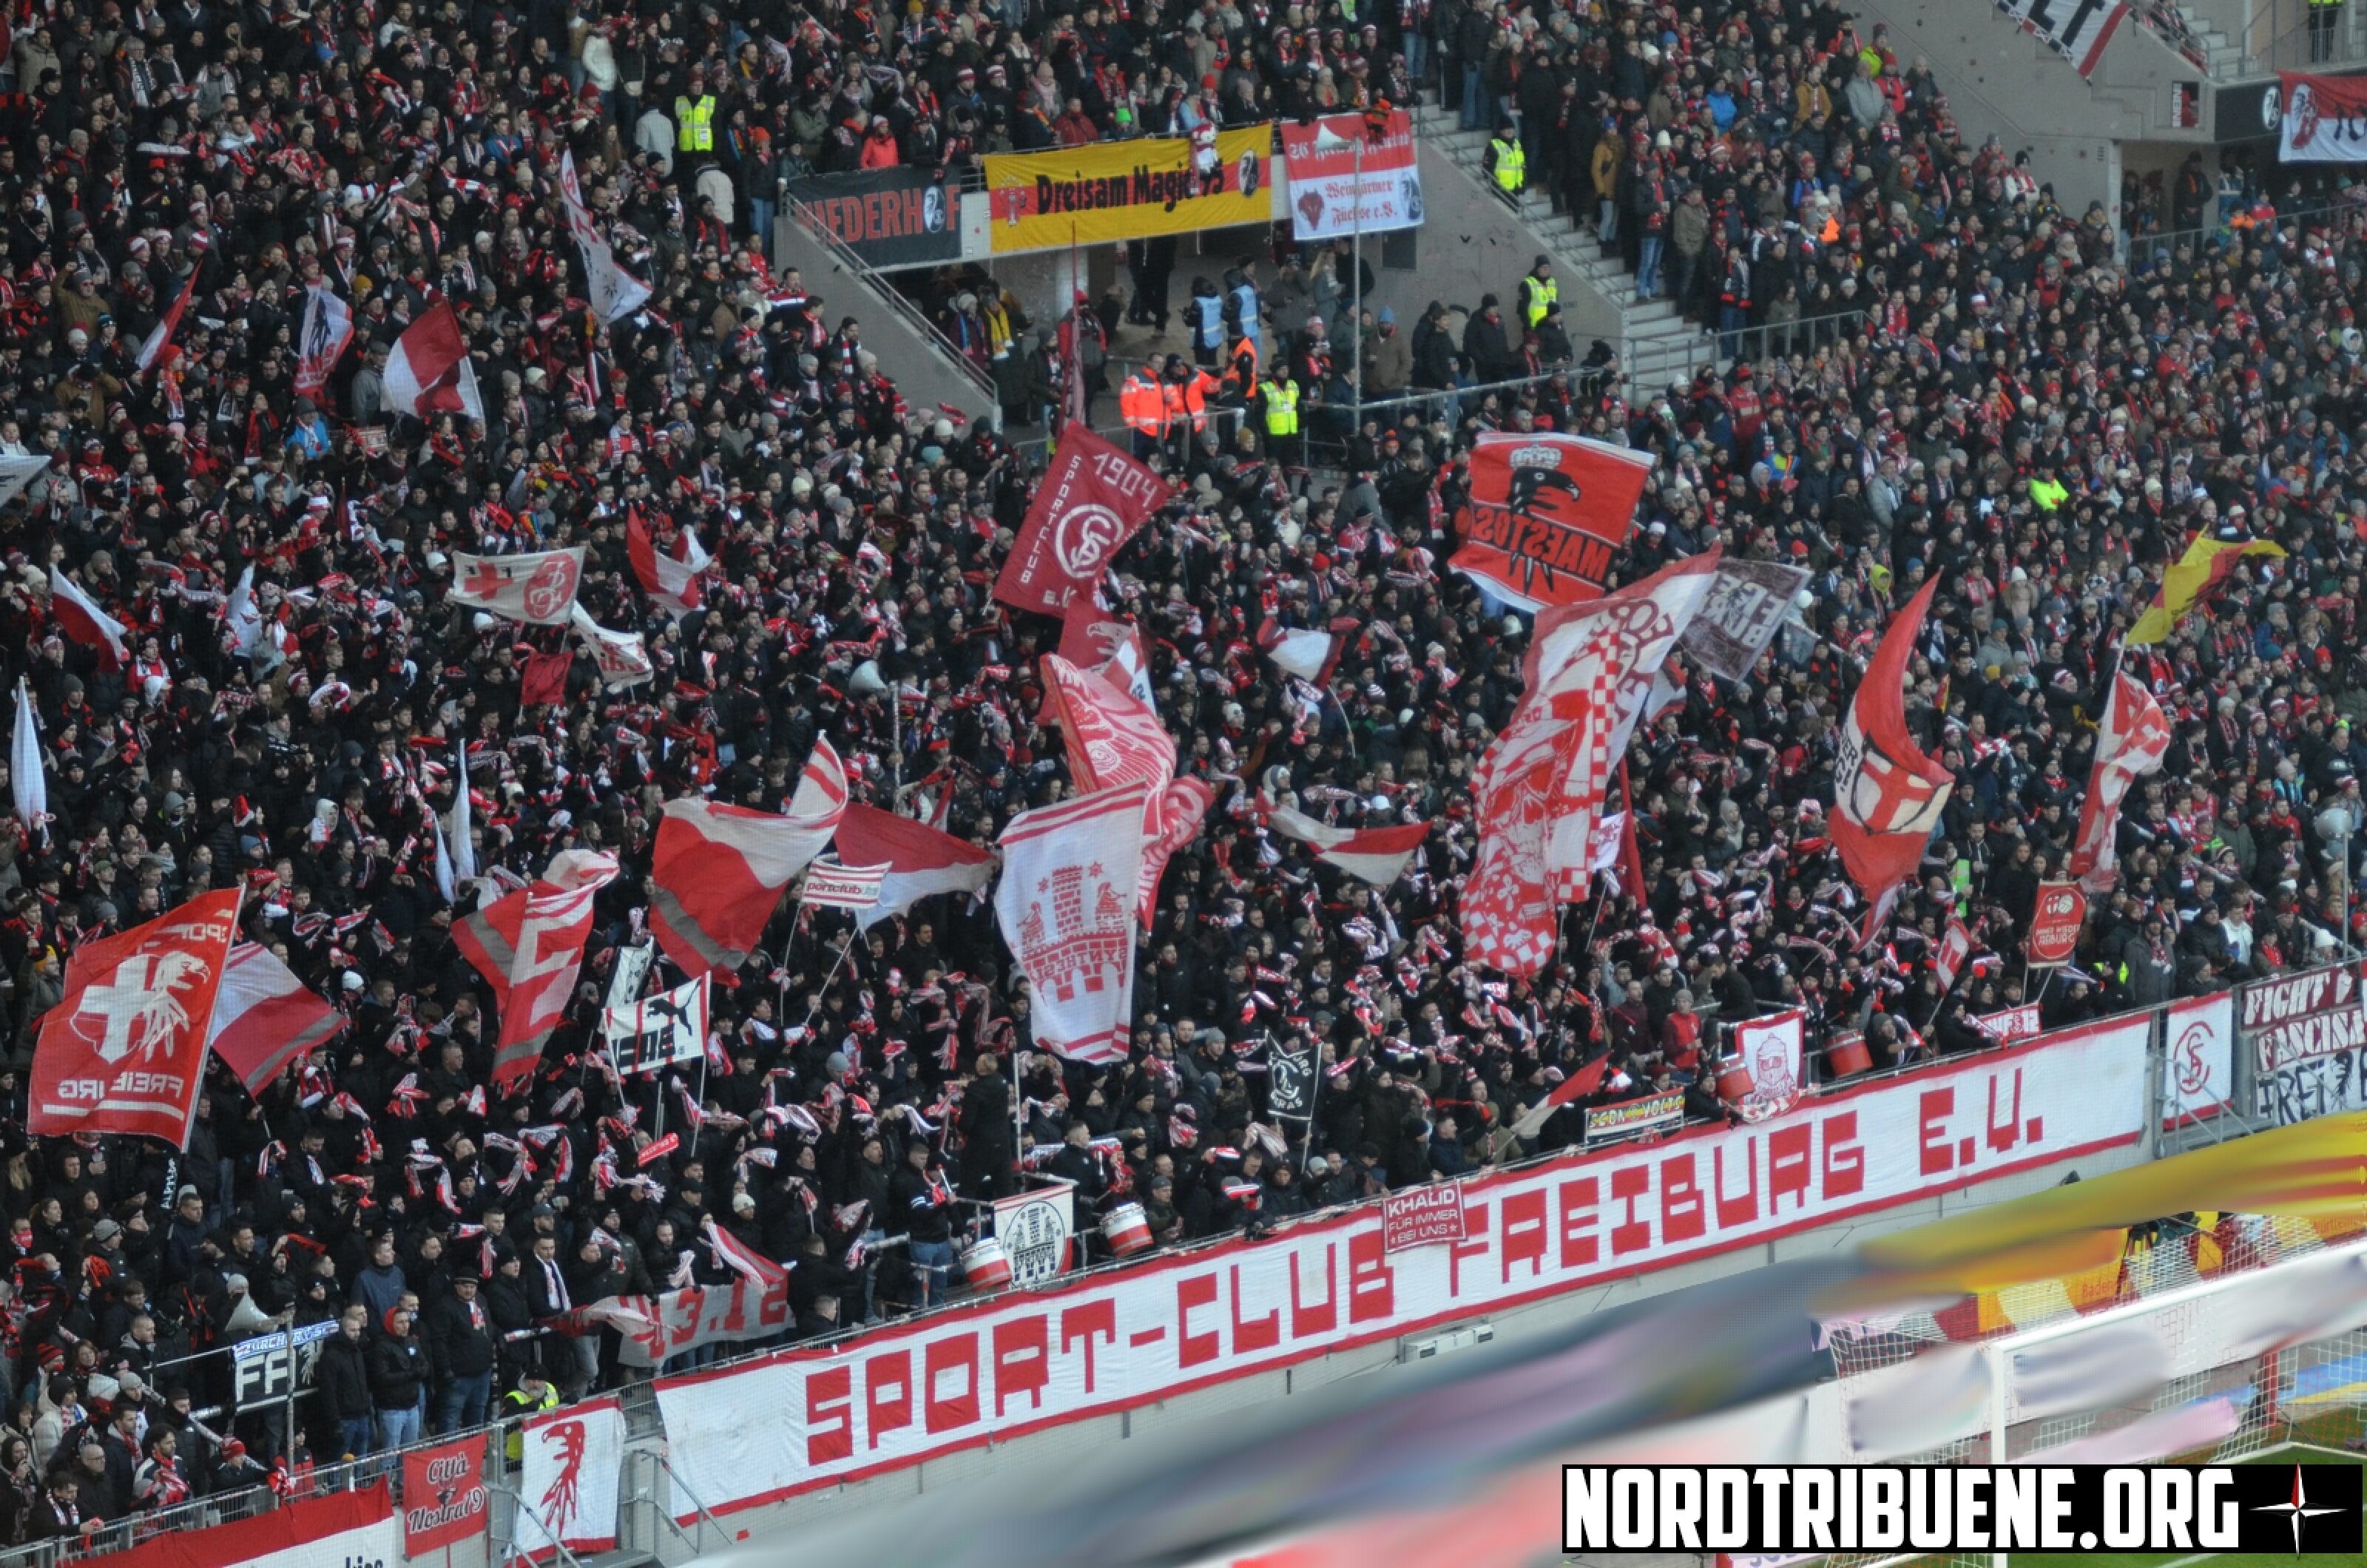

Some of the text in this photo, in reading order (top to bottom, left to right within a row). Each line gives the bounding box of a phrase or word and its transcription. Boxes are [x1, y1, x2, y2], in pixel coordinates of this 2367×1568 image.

[1036, 169, 1128, 214] Dreisam
[1093, 452, 1158, 508] 1904
[1388, 1189, 1456, 1218] KHALID
[1388, 1209, 1458, 1233] FÜR IMMER
[1419, 1224, 1448, 1237] UNS
[806, 1225, 1394, 1466] SPORT-CLUB
[1449, 1111, 1865, 1298] FREIBURG
